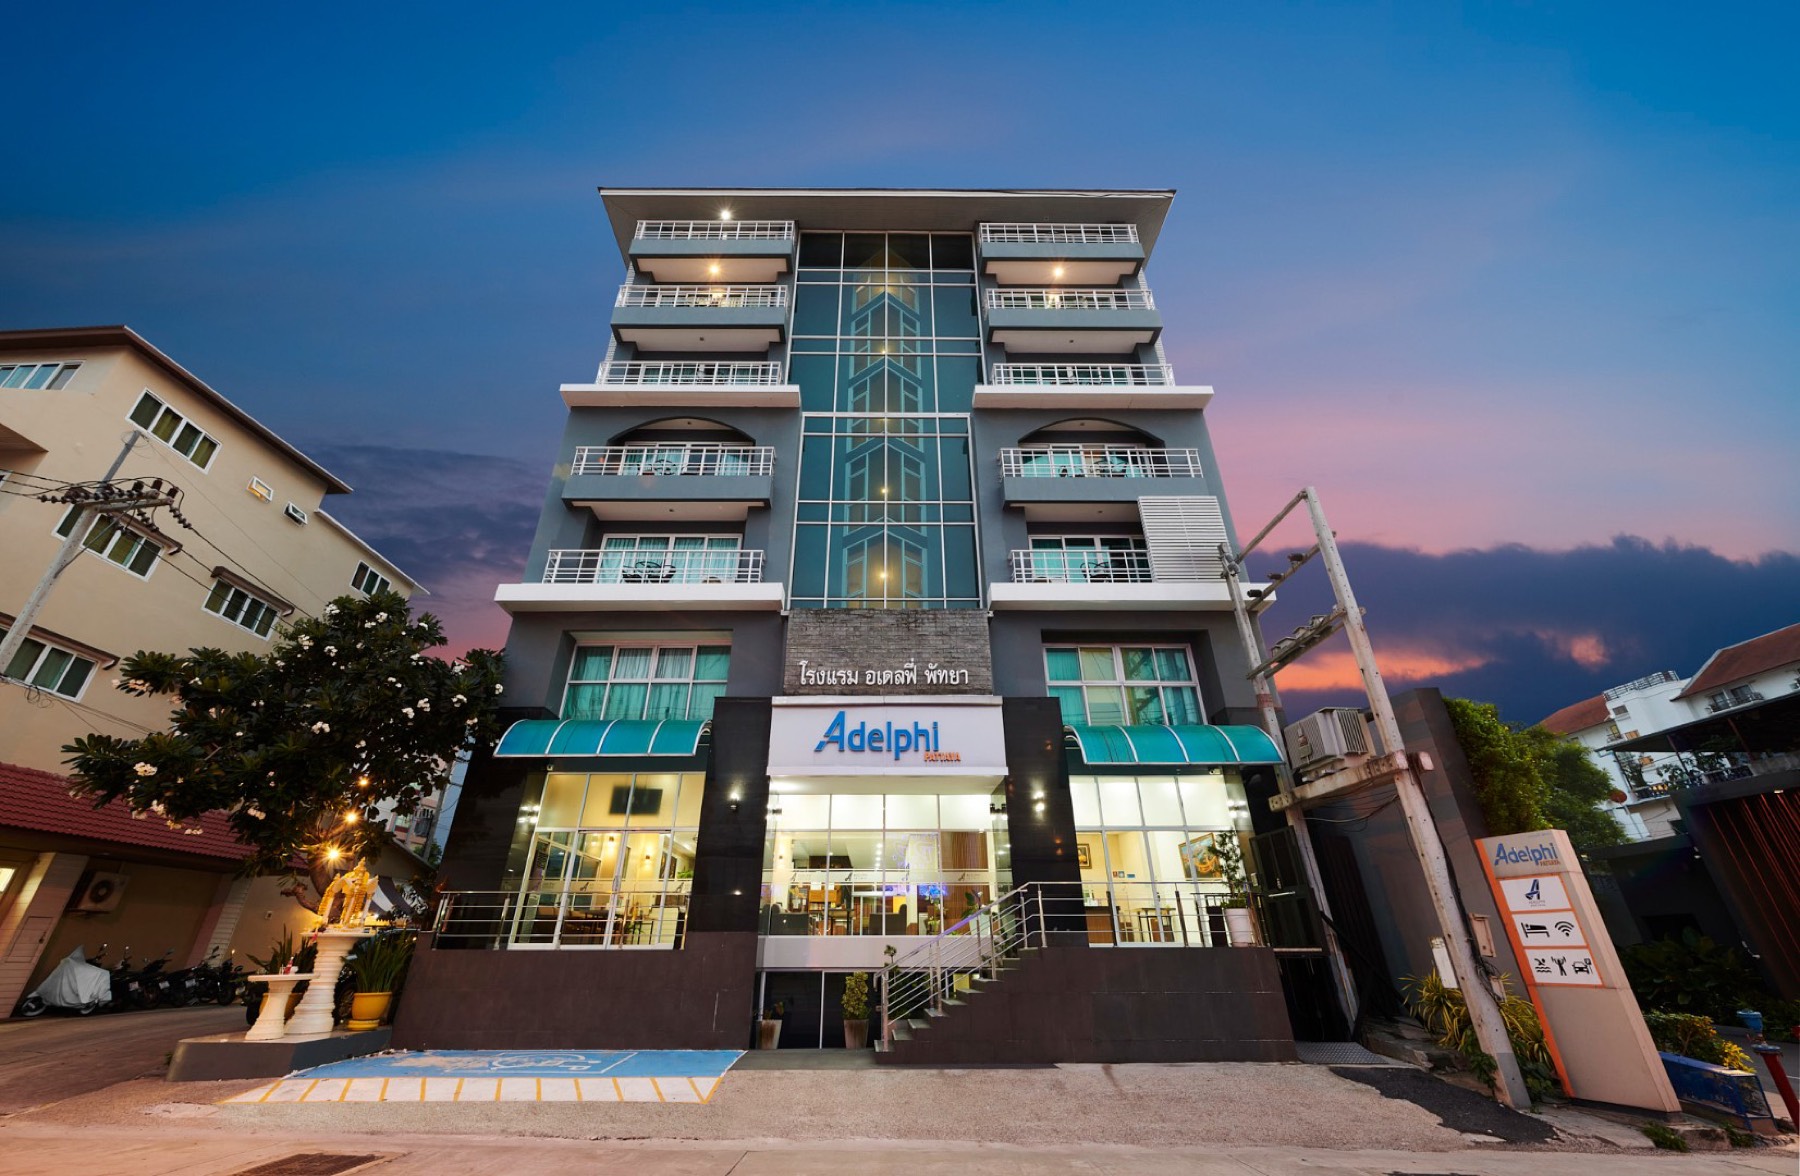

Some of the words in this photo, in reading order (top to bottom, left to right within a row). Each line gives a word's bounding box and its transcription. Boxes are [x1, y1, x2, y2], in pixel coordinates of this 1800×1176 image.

[799, 660, 859, 686] โรงแรม
[924, 662, 969, 685] พัทยา
[814, 711, 939, 760] Adelphi
[1494, 842, 1558, 866] Adelphi
